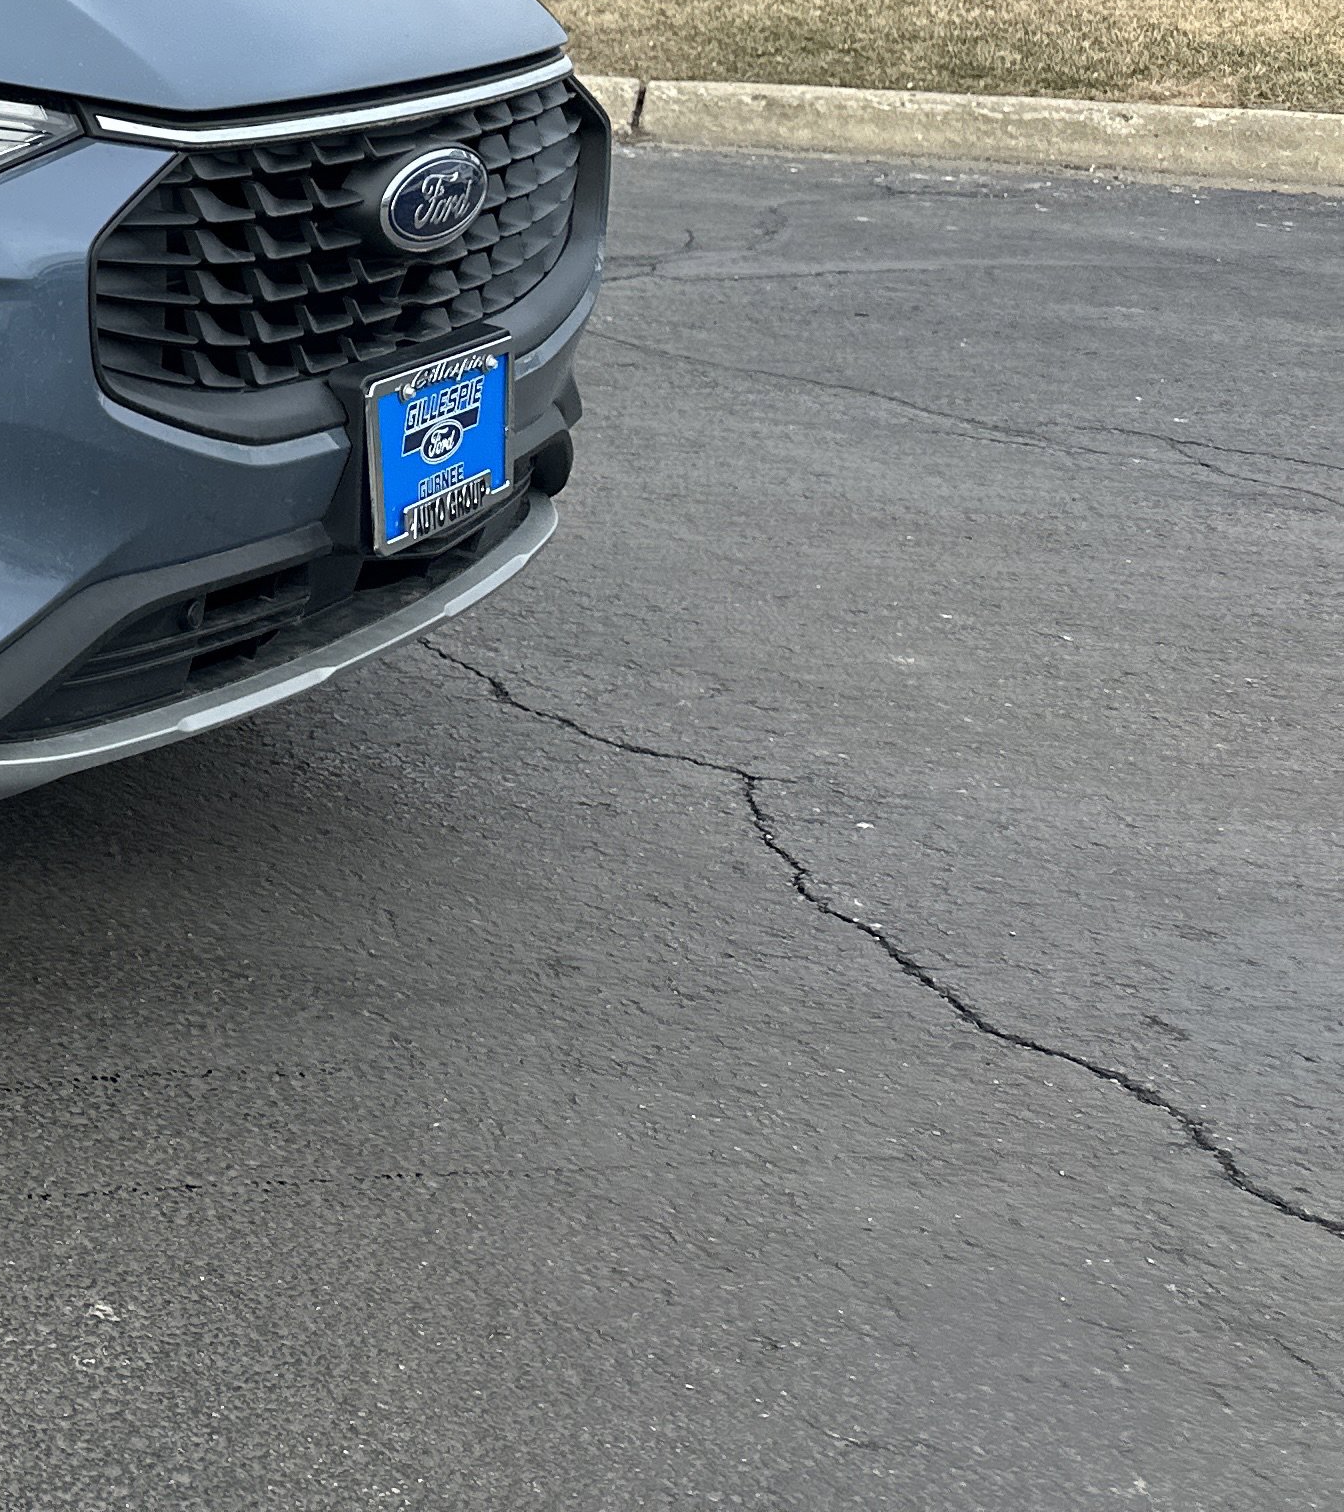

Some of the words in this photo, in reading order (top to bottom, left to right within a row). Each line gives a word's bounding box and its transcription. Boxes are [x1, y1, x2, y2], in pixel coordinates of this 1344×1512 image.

[414, 171, 473, 230] Ford
[404, 374, 485, 432] GILLESPIE
[428, 427, 456, 458] Ford
[410, 496, 446, 539] AUTO
[447, 478, 488, 522] GROUP
[418, 462, 465, 500] GURNEE
